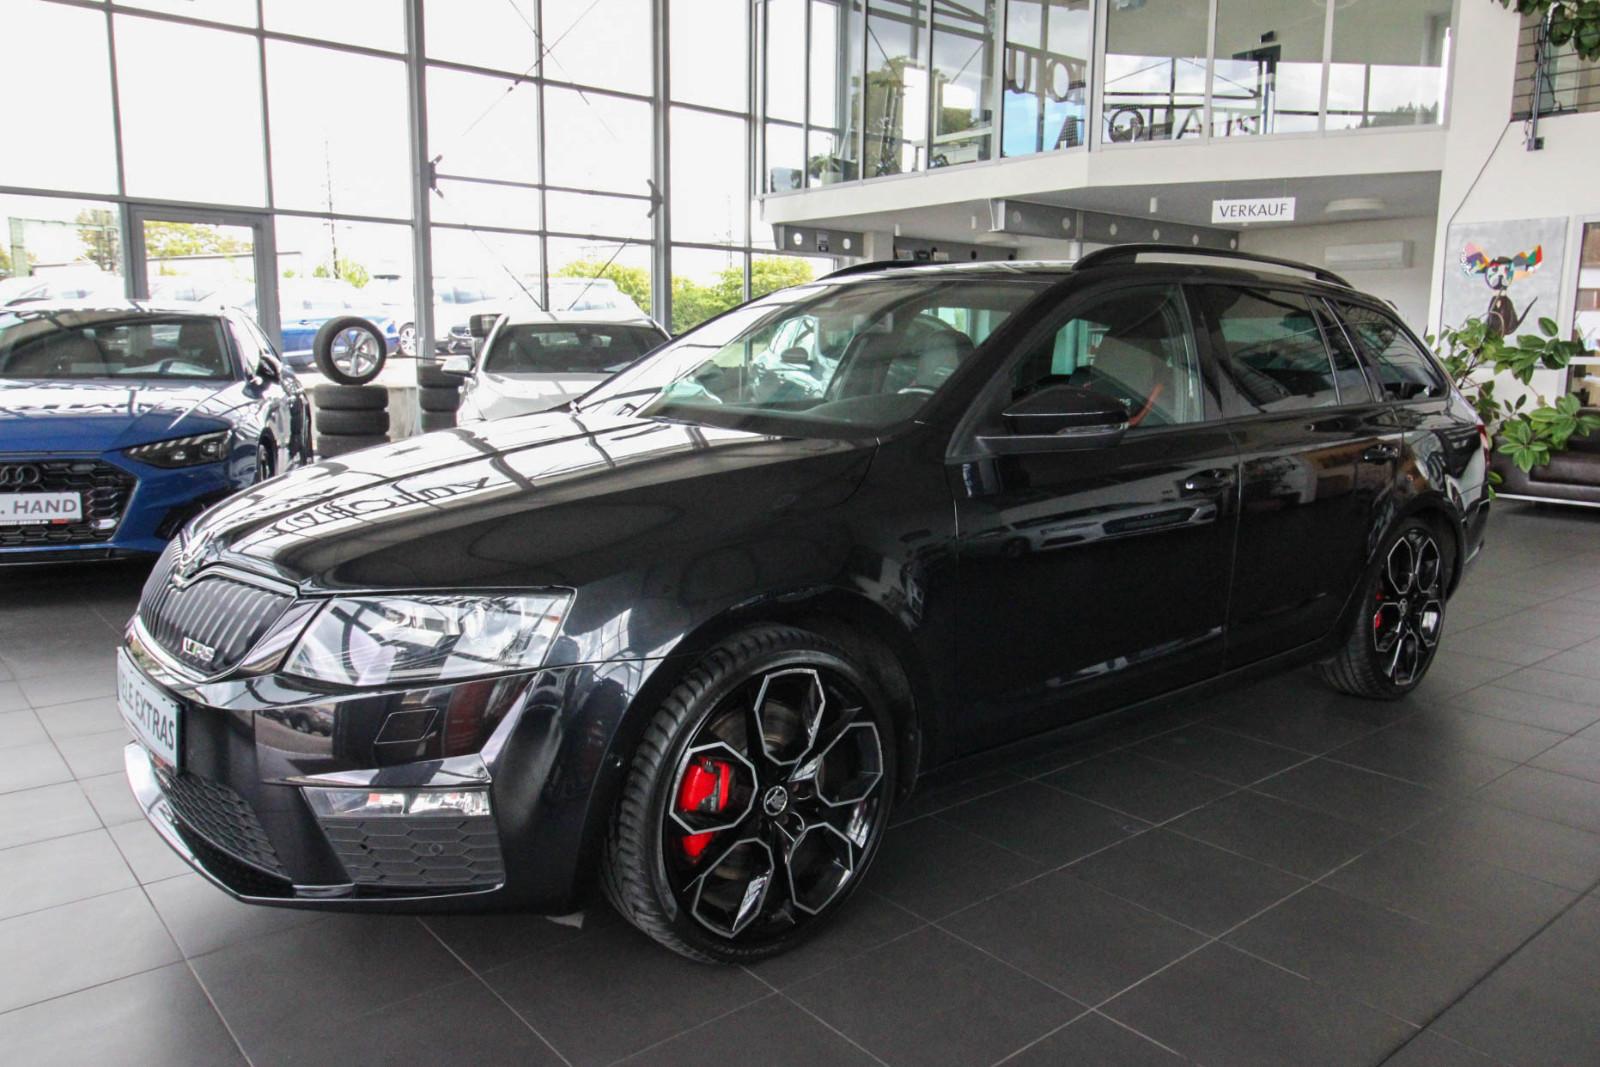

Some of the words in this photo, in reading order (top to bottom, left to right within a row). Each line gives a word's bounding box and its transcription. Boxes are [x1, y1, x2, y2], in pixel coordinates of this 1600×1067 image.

[1219, 202, 1288, 217] VERKAUF
[13, 499, 77, 515] HAND
[136, 690, 175, 751] EXTRAS
